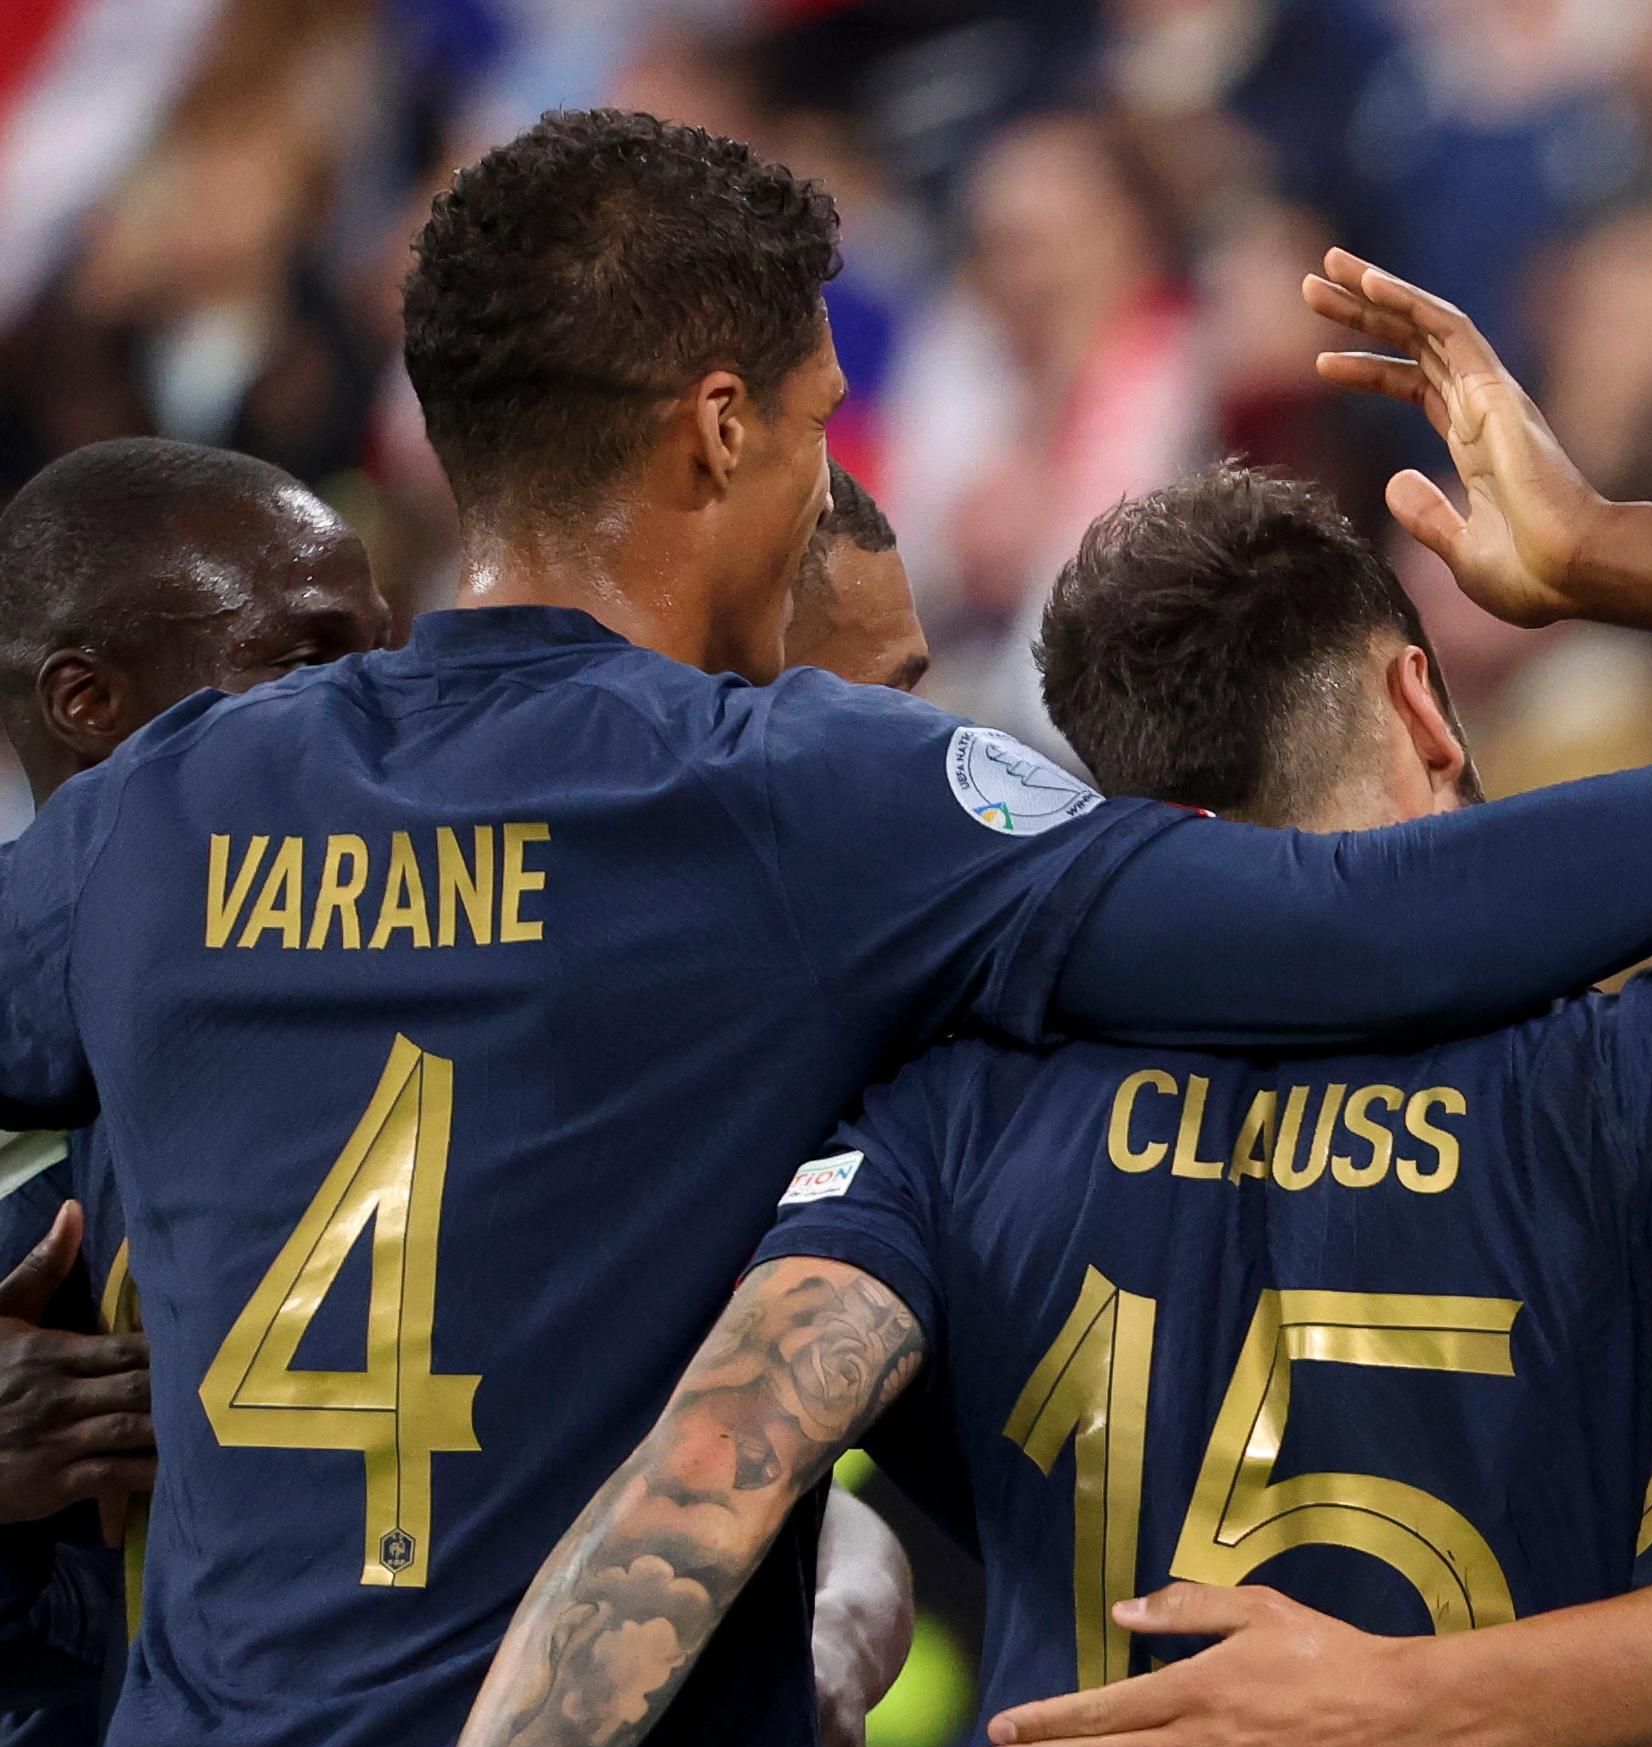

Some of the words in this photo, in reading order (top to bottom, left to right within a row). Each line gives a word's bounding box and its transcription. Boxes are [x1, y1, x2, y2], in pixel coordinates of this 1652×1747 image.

[206, 823, 550, 949] VARANE
[1107, 1069, 1467, 1194] CLAUSS
[199, 1032, 482, 1588] 4
